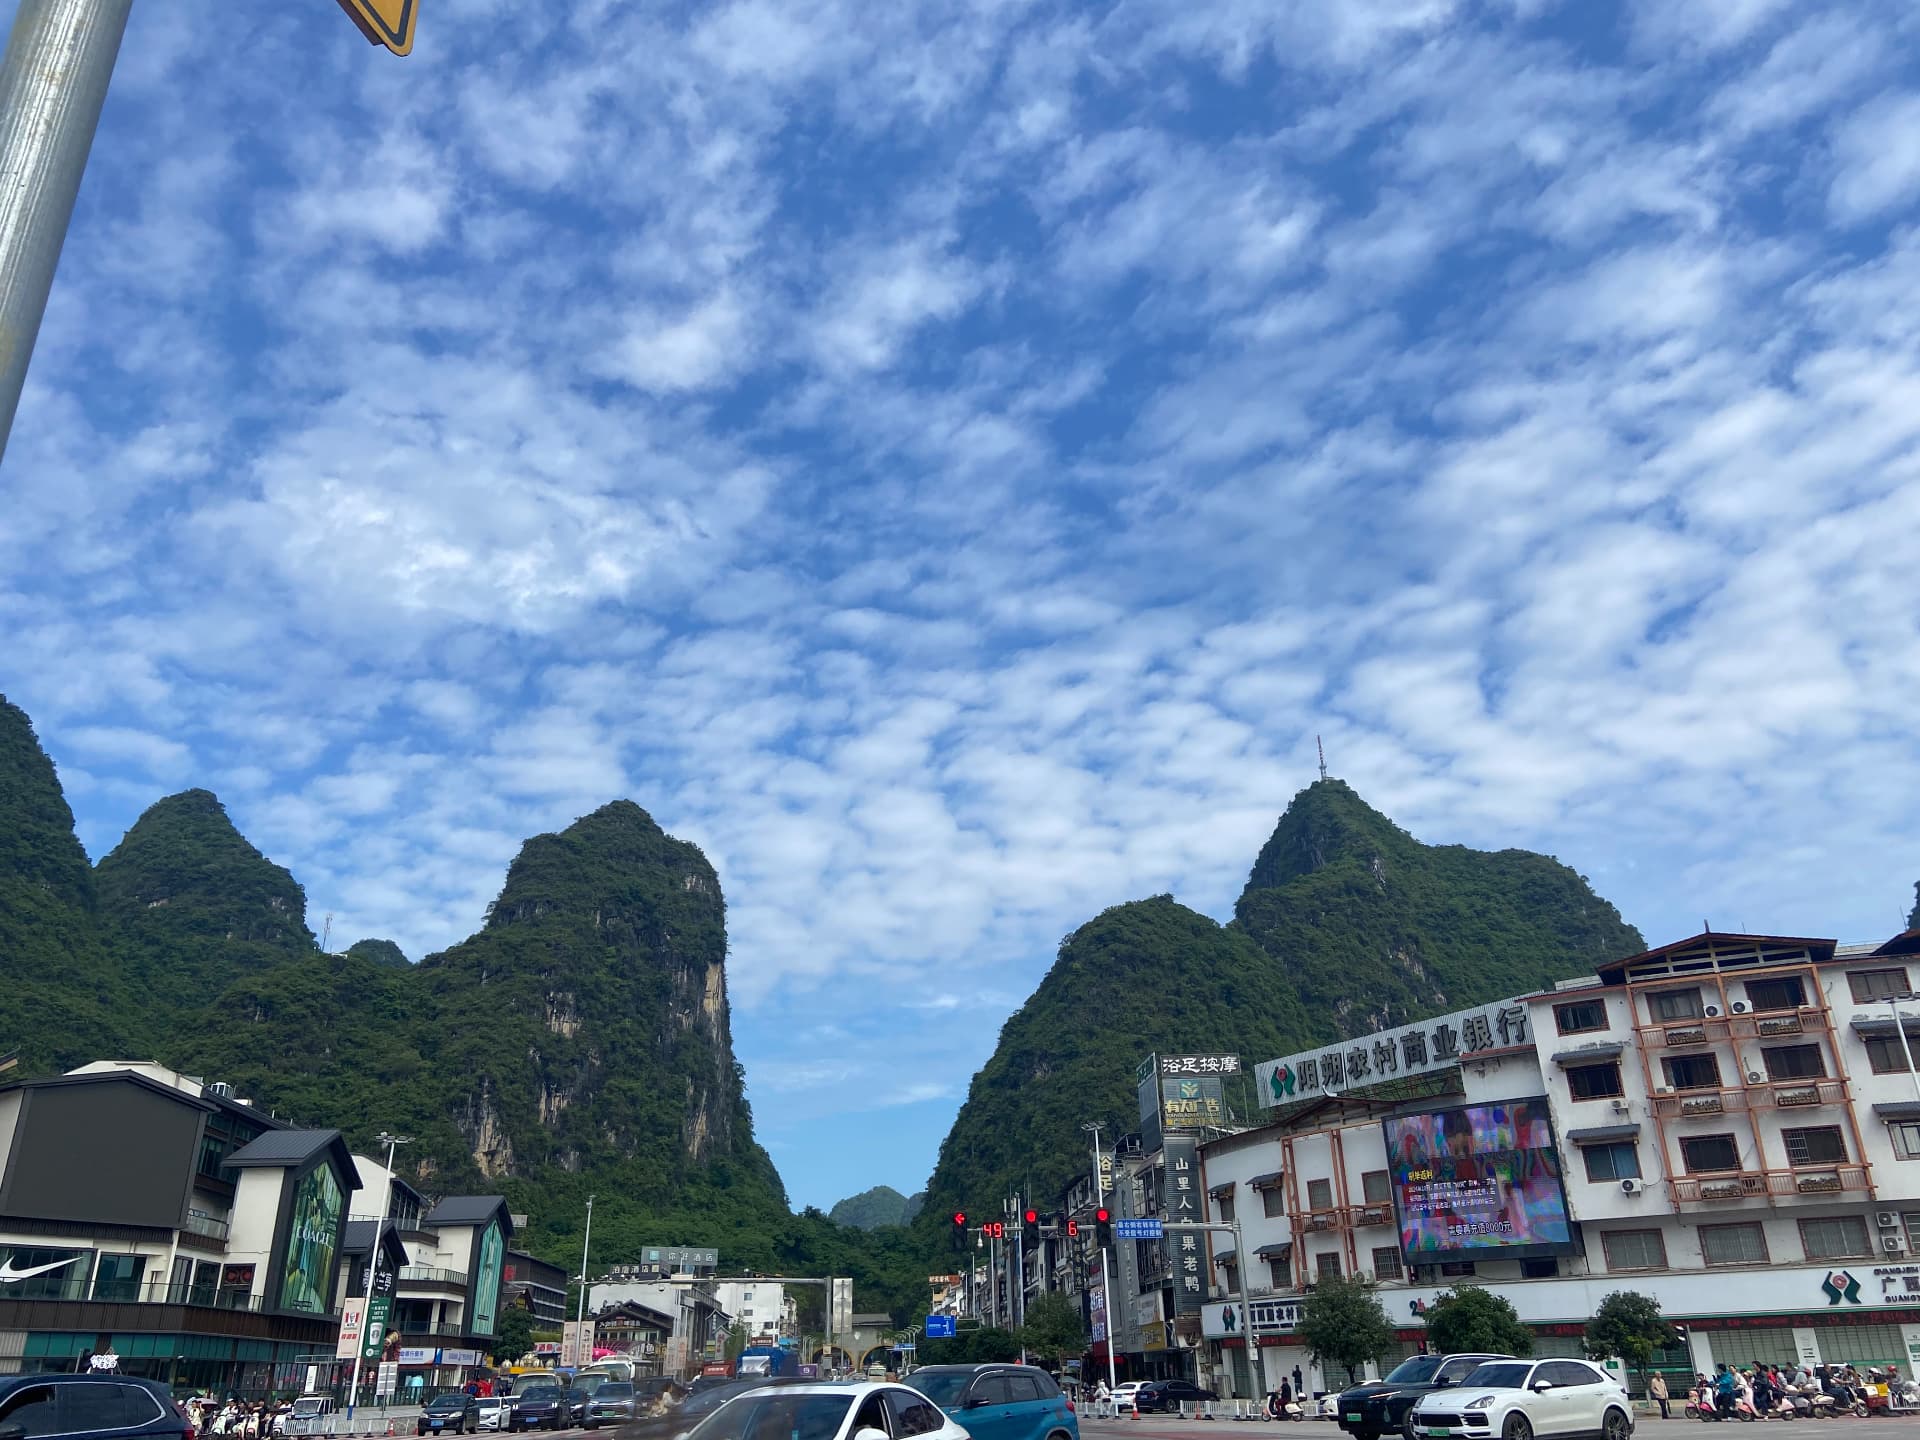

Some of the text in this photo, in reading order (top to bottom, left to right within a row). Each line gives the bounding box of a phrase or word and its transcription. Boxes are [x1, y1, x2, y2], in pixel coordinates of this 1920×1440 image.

[1296, 1006, 1527, 1092] 阳朔农村商业银行
[1163, 1056, 1239, 1073] 浴足按摩
[1165, 1098, 1220, 1113] 有为广告
[984, 1222, 1002, 1238] 49
[1068, 1221, 1077, 1236] 6
[1881, 1276, 1920, 1293] 广西
